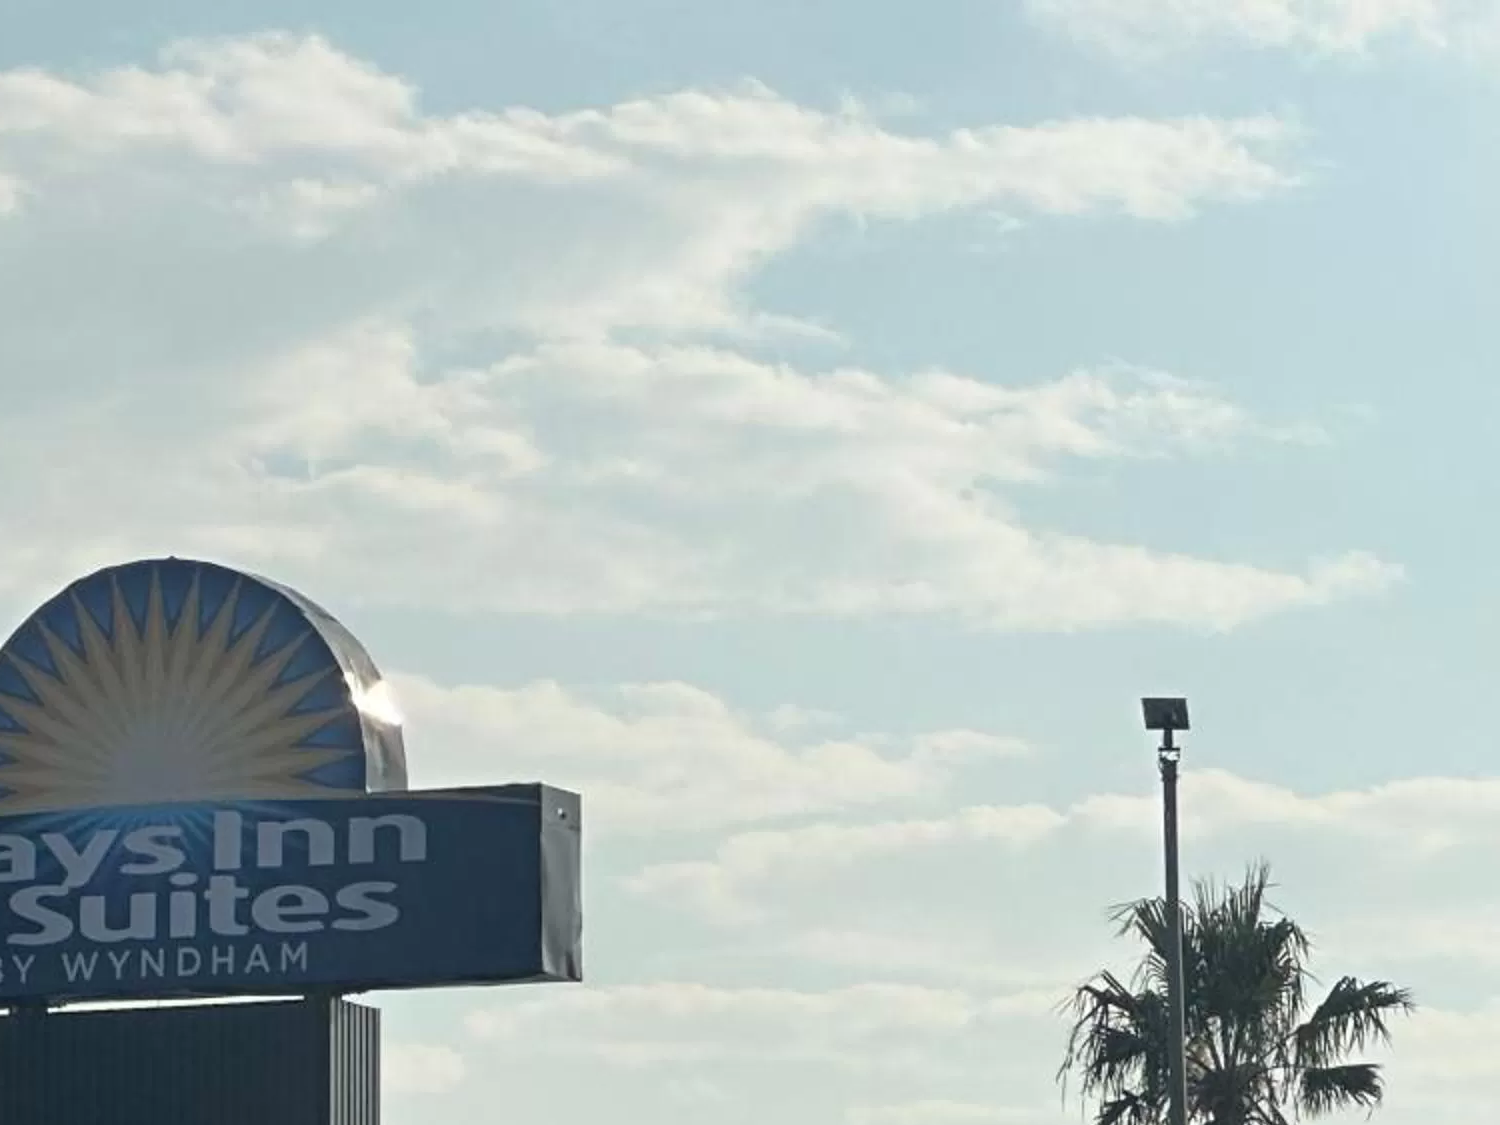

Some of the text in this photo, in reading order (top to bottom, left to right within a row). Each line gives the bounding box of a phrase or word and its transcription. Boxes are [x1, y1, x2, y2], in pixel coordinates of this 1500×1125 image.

[213, 811, 428, 871] Inn
[6, 873, 399, 946] Suites
[62, 942, 308, 981] WYNDHAM
